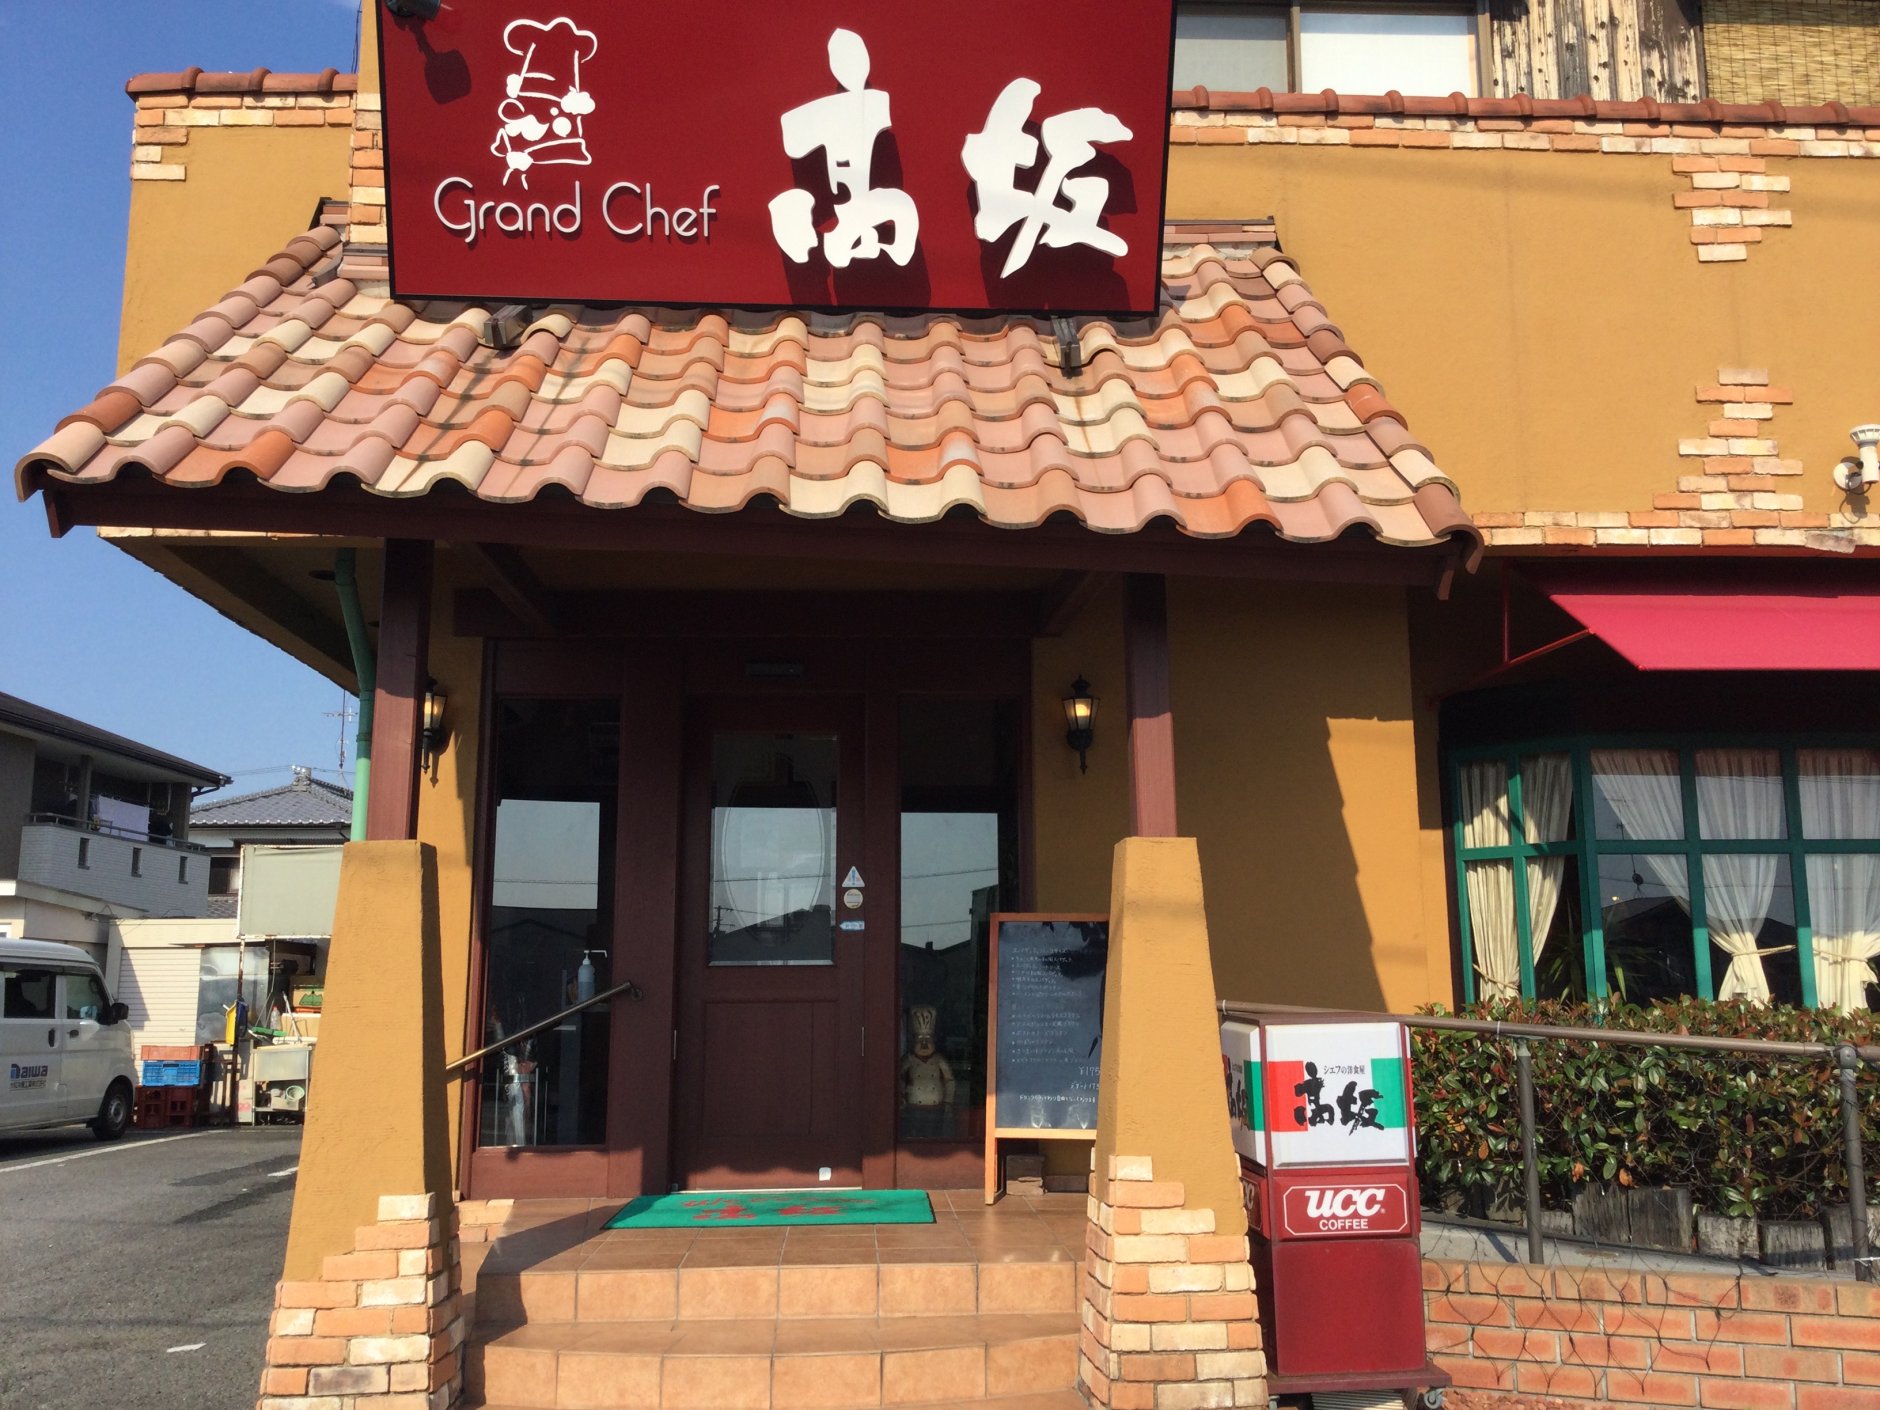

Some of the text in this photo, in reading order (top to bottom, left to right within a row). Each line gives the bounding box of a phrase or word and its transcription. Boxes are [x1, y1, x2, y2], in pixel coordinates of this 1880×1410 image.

[768, 27, 1134, 279] 高坂
[434, 177, 721, 243] Grand Chef
[10, 1063, 48, 1079] Daiwa
[1294, 1061, 1385, 1136] 高坂
[1305, 1188, 1386, 1218] UCC
[1319, 1218, 1368, 1231] COFFEE
